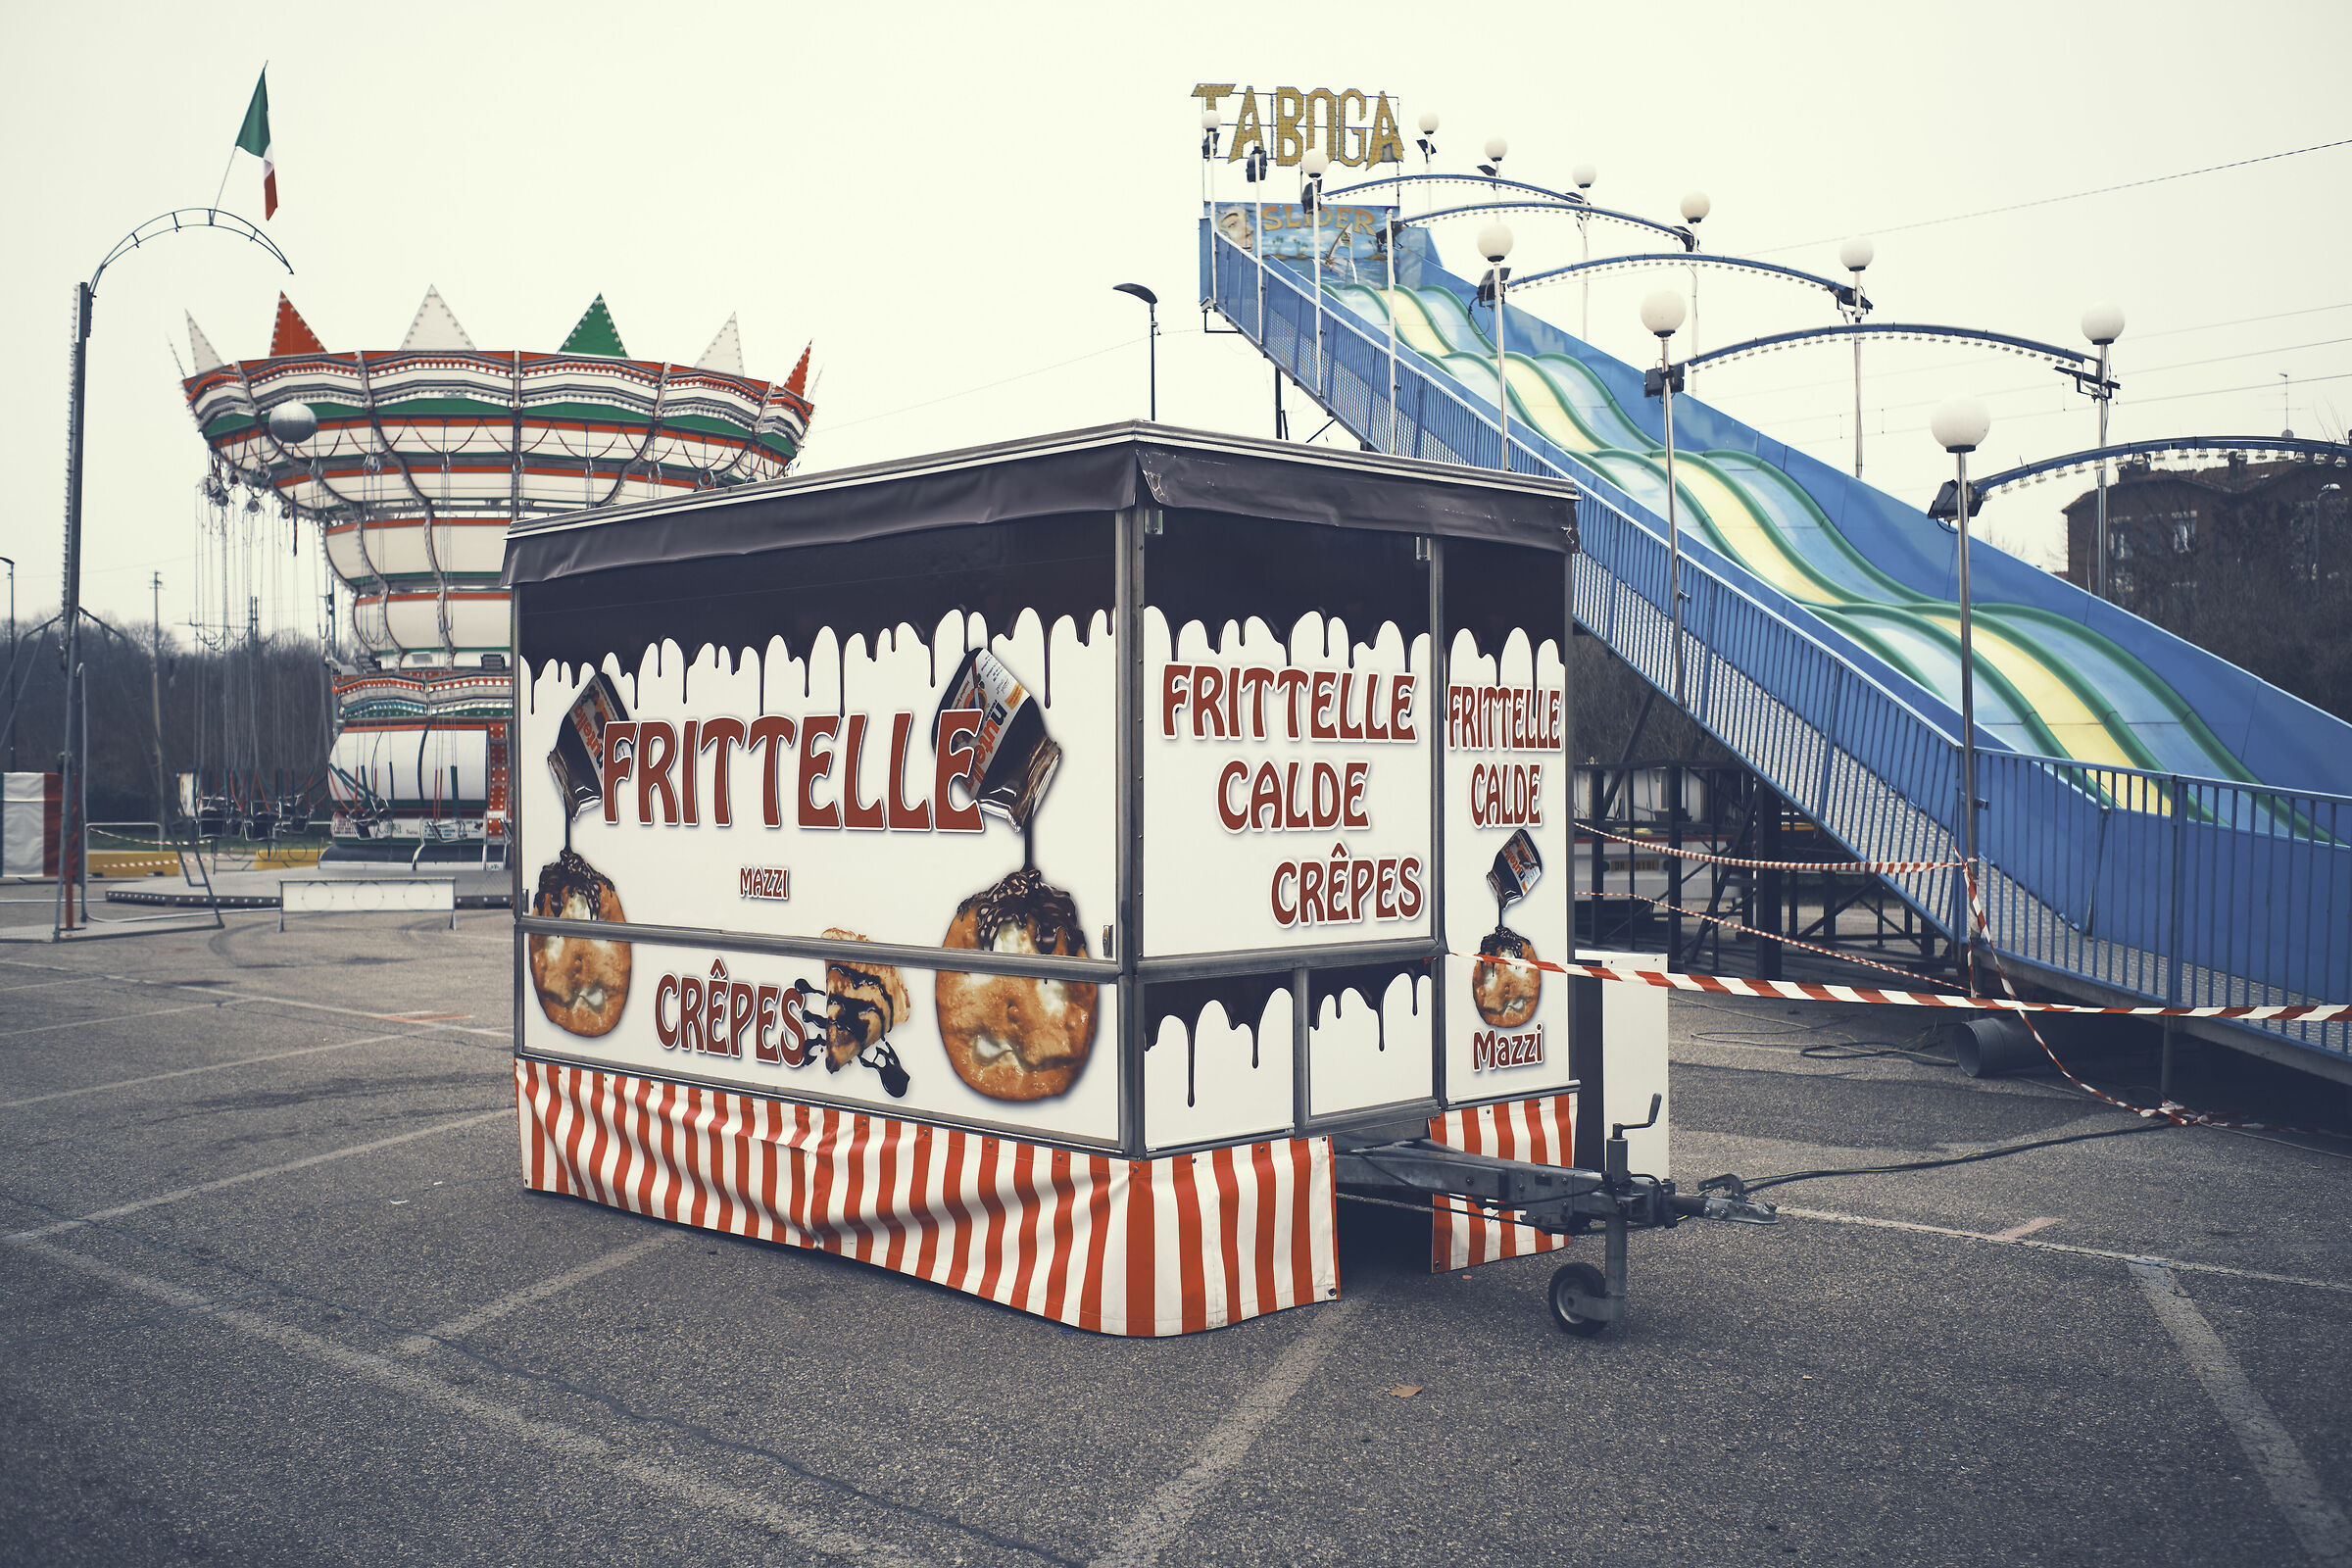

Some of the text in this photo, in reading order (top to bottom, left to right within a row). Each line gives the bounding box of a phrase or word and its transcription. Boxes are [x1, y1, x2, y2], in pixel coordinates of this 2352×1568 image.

[1191, 83, 1404, 171] TABOGA
[1162, 664, 1415, 741] FRITTELLE
[1448, 685, 1561, 750] FRITTELLE
[604, 710, 984, 831] FRITTELLE
[1217, 760, 1368, 830] CALDE
[1471, 762, 1541, 826] CALDE
[740, 867, 788, 898] MAZZI
[1271, 842, 1421, 925] CRÊPES
[656, 957, 806, 1066] CRÊPES
[1474, 1025, 1543, 1069] Mazzi
